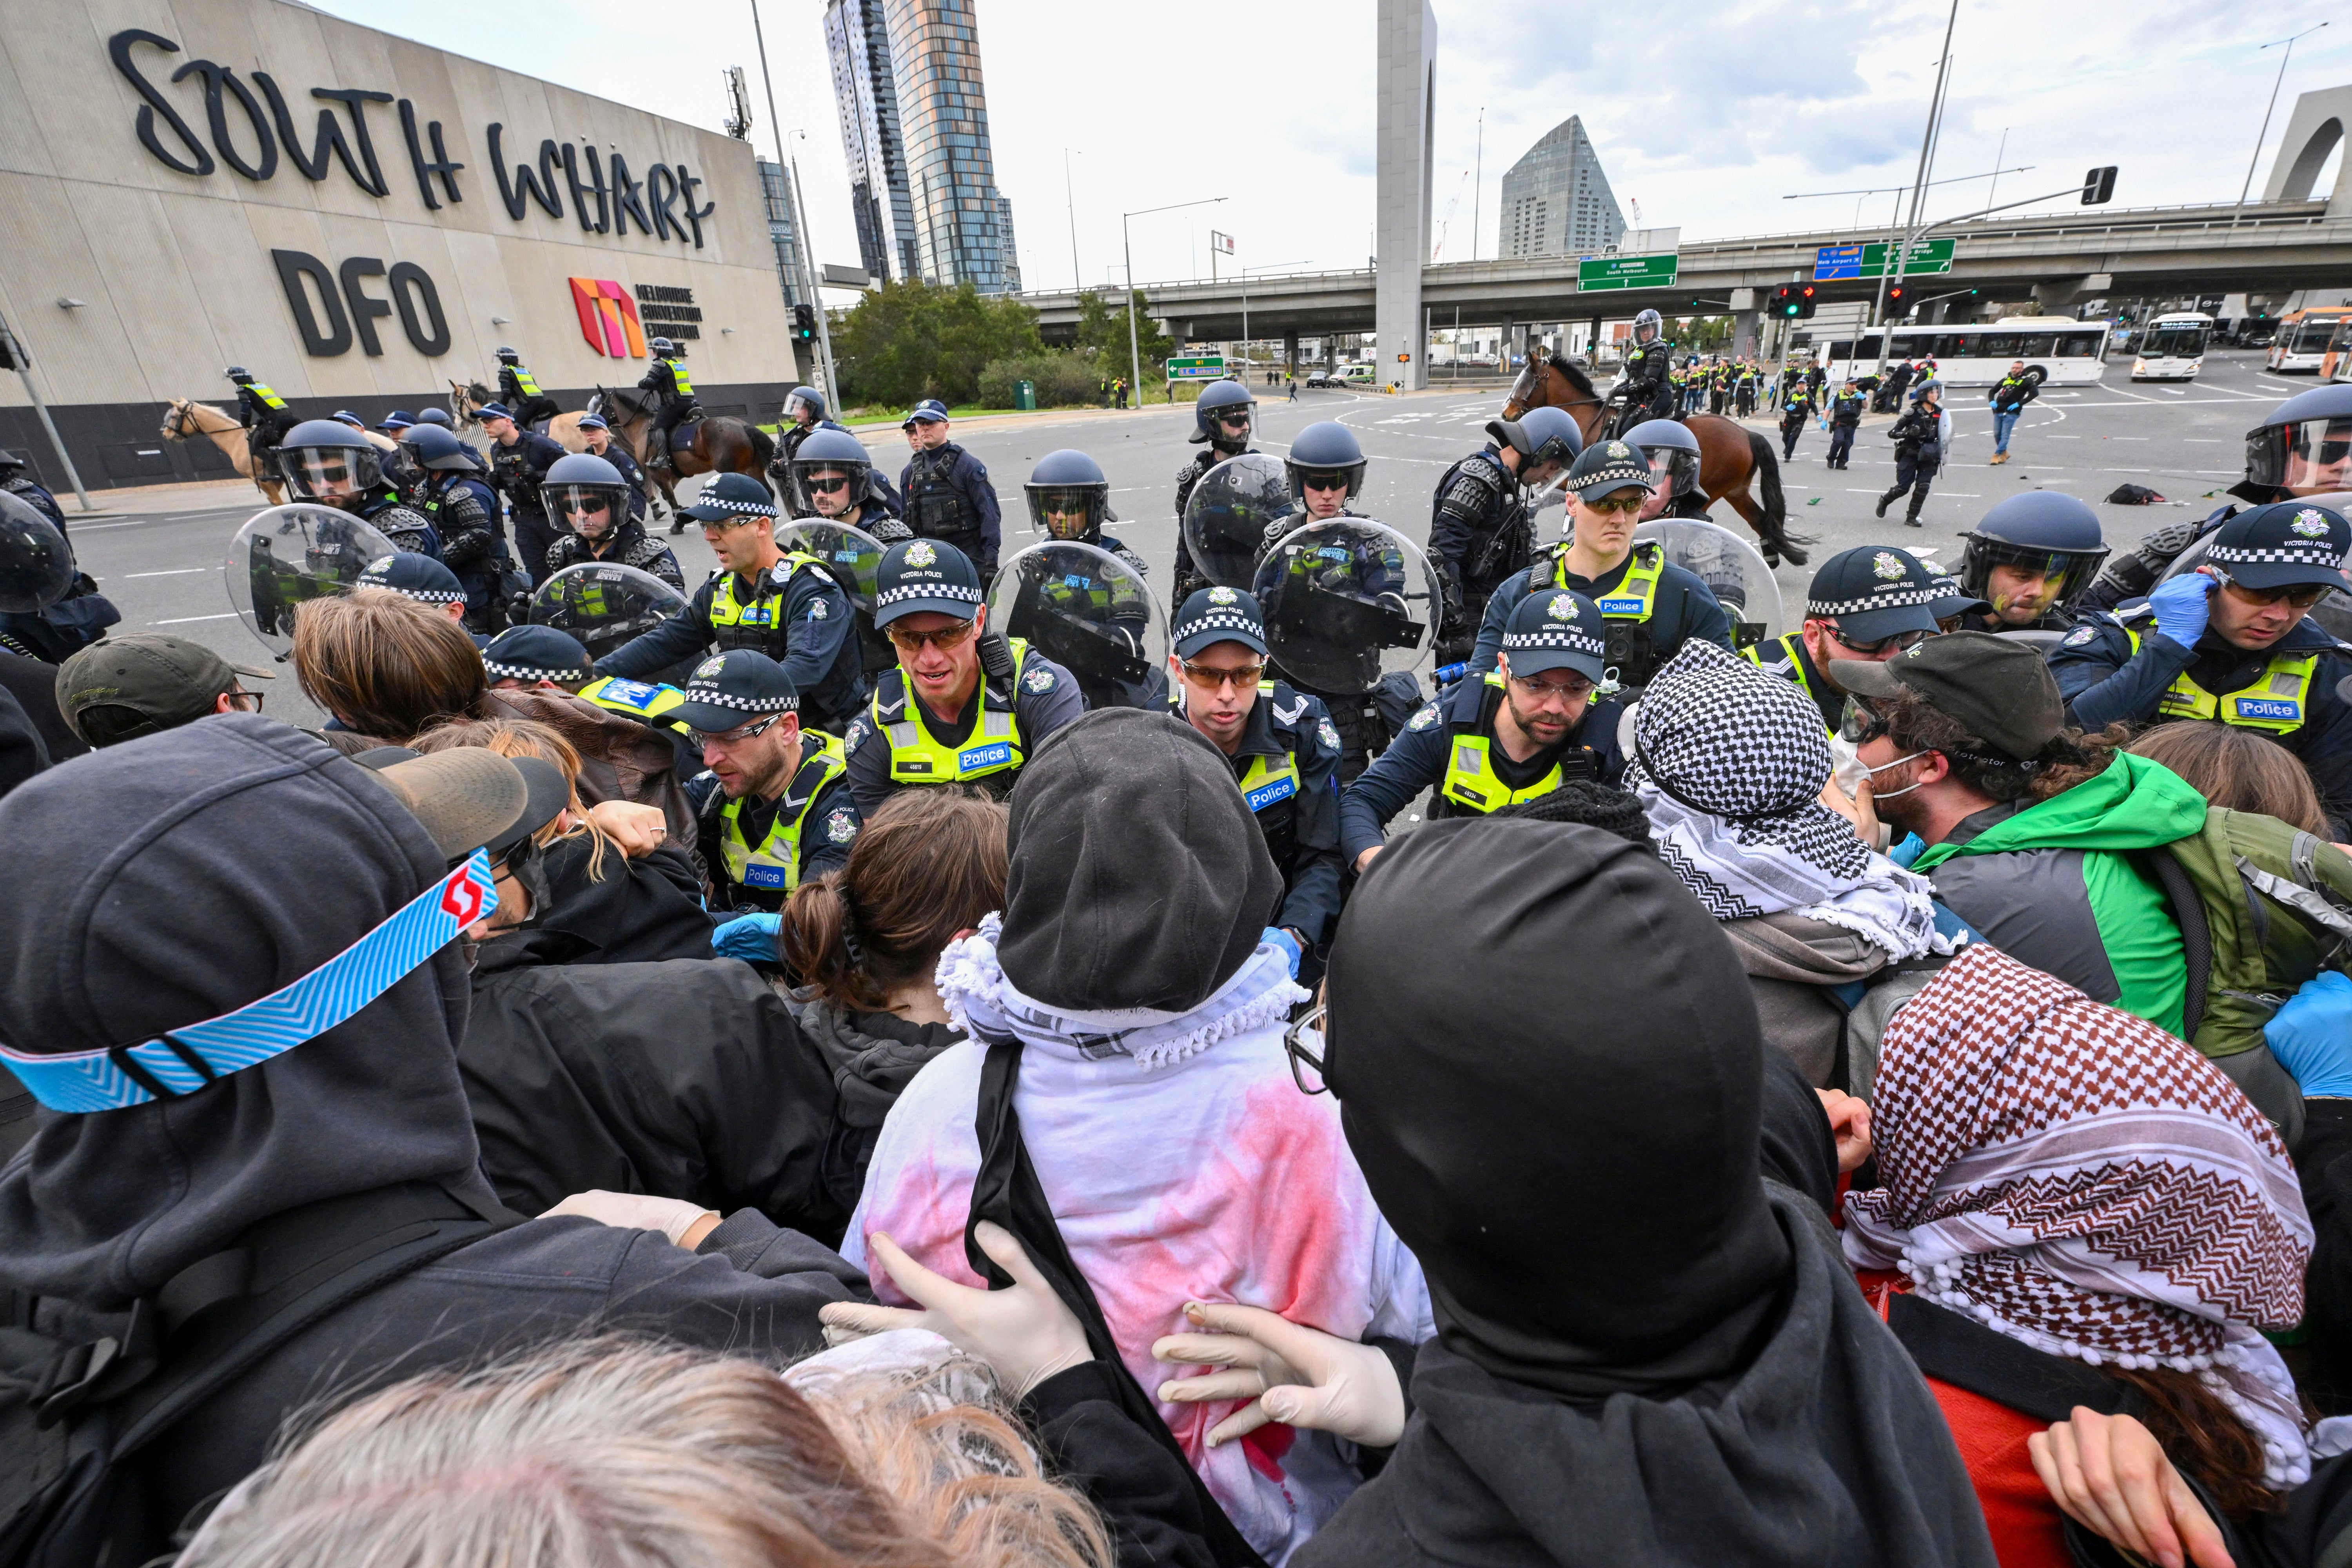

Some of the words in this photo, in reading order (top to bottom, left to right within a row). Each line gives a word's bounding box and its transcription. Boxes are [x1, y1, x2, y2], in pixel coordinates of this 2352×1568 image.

[109, 29, 465, 210] SOUTH
[488, 122, 715, 249] WHARF
[635, 284, 695, 304] MELBOURNE
[271, 249, 451, 357] DFO
[640, 303, 703, 322] CONVENTION
[644, 323, 701, 339] EXHIBITION
[2314, 541, 2332, 549] POLICE
[900, 571, 923, 579] VICTORIA
[924, 570, 942, 579] POLICE
[746, 610, 768, 619] Poce
[1228, 607, 1243, 615] POLICE
[1566, 624, 1583, 634] POLICE
[2243, 702, 2293, 715] Police
[862, 724, 870, 735] POLICE
[964, 749, 1004, 766] Police
[1251, 784, 1290, 806] Police
[1464, 790, 1476, 799] 49334
[748, 868, 780, 883] Police
